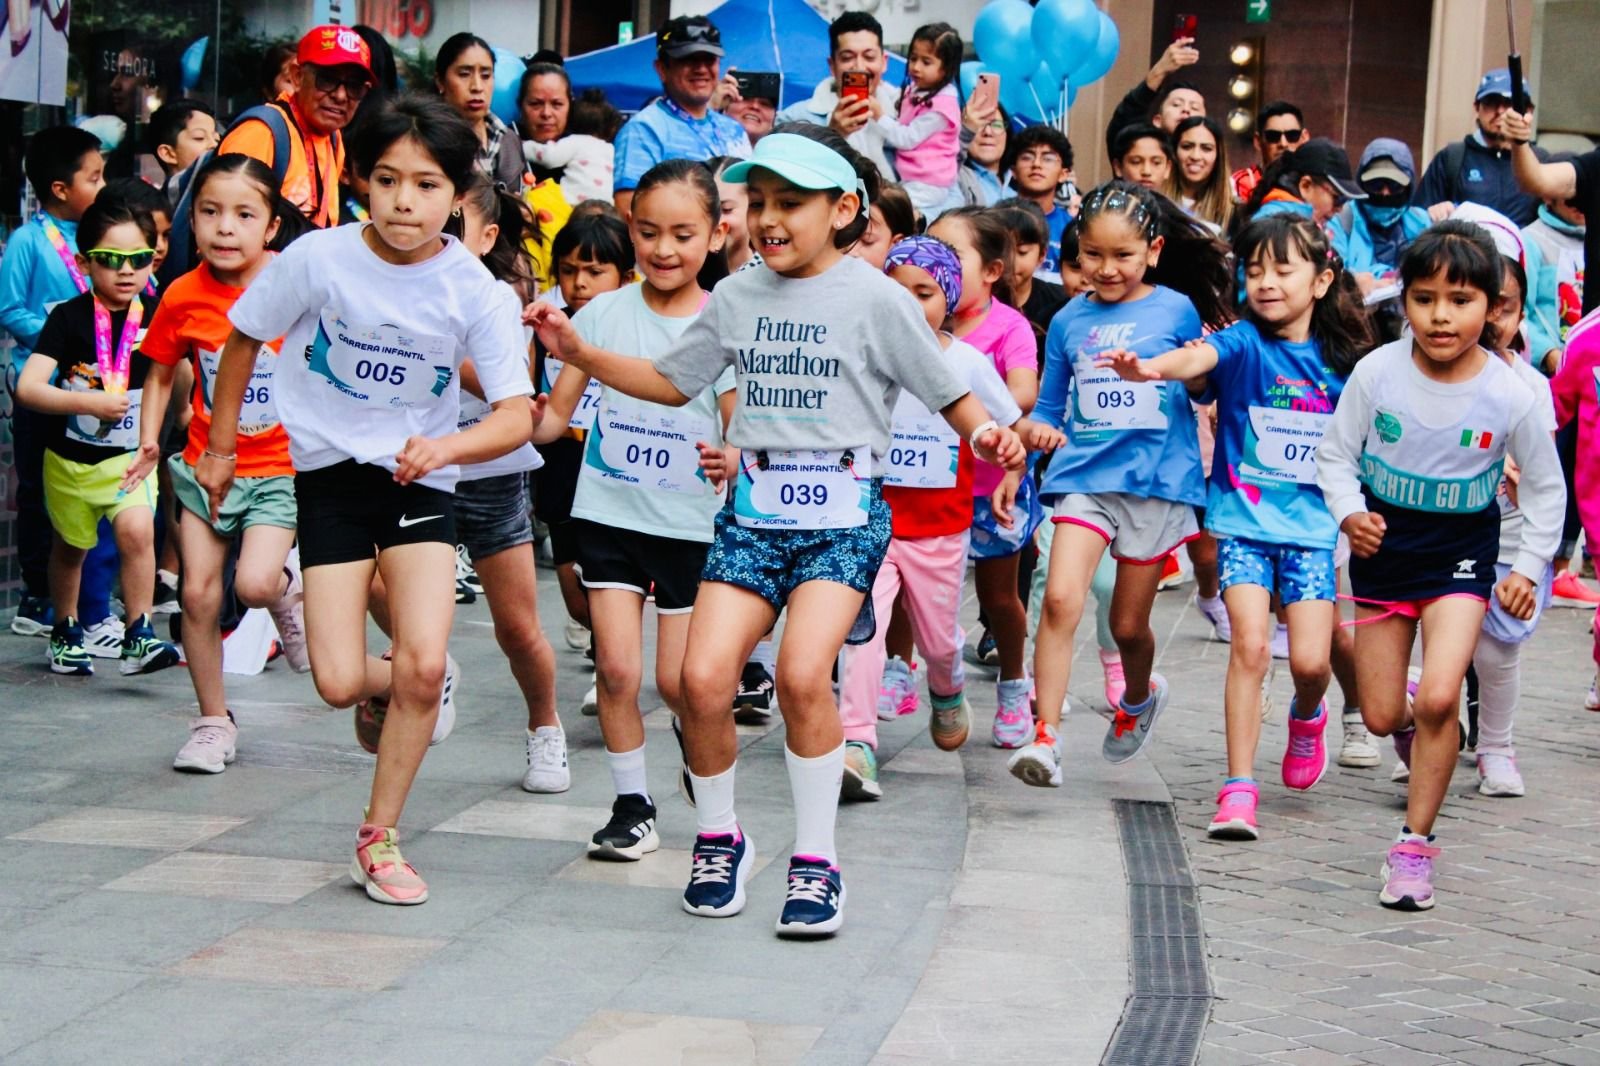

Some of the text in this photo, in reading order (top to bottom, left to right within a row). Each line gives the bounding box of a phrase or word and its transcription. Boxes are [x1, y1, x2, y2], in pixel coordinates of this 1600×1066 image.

[103, 50, 157, 78] SEPHORA
[754, 316, 827, 344] Future
[338, 333, 381, 352] CARRERA
[381, 346, 426, 361] INFANTIL
[738, 346, 840, 377] Marathon
[355, 359, 407, 386] 005
[243, 386, 269, 404] 96
[745, 380, 829, 410] Runner
[1097, 390, 1136, 409] 093
[457, 417, 481, 428] ANTIL
[609, 421, 688, 442] CARRERA INFANTIL
[1265, 425, 1303, 437] CARRERA
[905, 434, 941, 443] INFANTIL
[626, 444, 670, 469] 010
[890, 448, 927, 467] 021
[799, 464, 844, 473] INFANTIL
[1265, 470, 1297, 479] DECATHLON
[780, 483, 828, 506] 039
